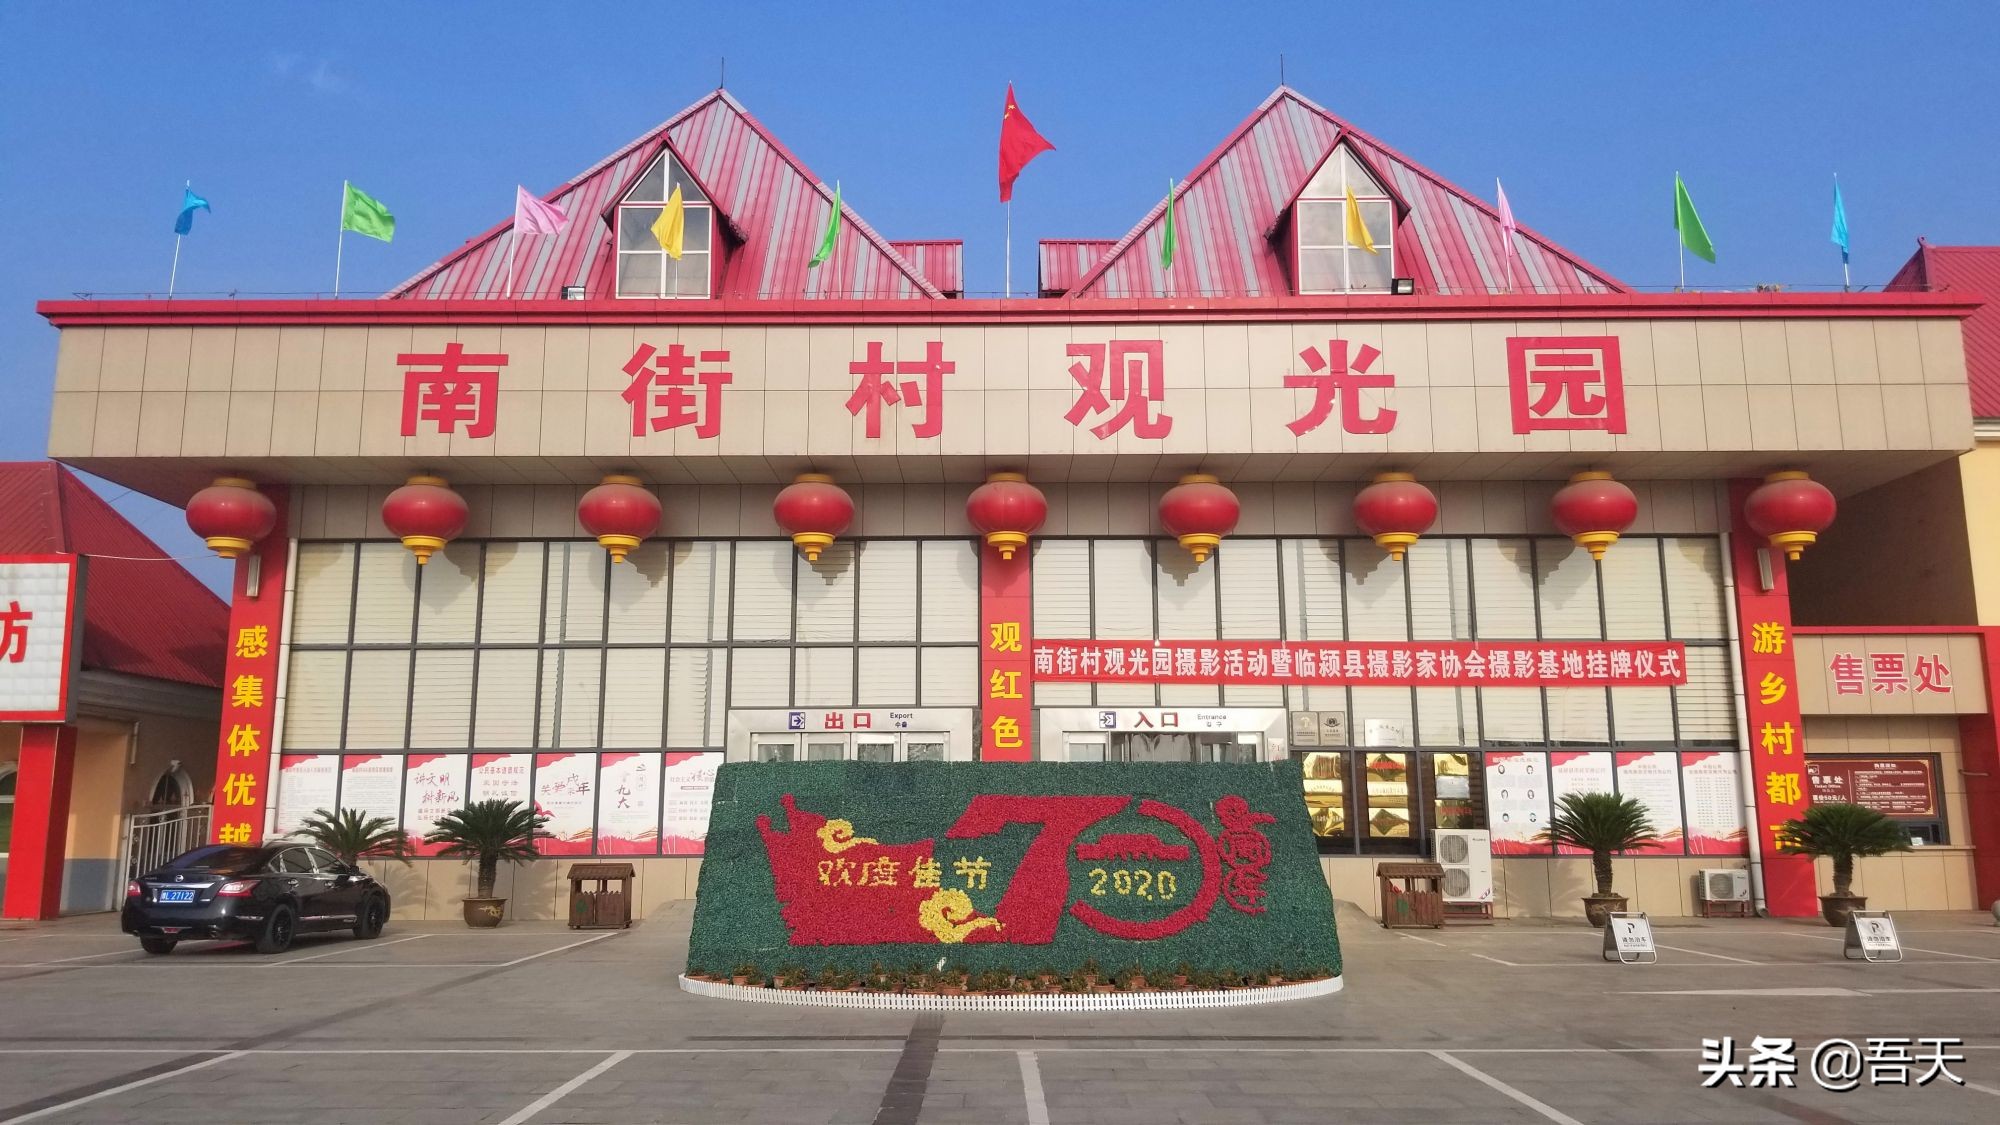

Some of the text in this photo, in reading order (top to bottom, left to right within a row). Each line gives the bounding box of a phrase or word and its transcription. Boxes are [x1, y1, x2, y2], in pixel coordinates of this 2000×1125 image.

[396, 335, 1627, 438] 南街村观光园
[990, 622, 1023, 748] 观红色
[1828, 652, 1952, 695] 售票处
[824, 711, 871, 729] 出口
[1133, 711, 1179, 728] 入口
[1197, 713, 1227, 721] Entrance
[218, 625, 268, 844] 感集体优越
[818, 856, 992, 889] 欢度佳节
[1088, 868, 1177, 901] 2020
